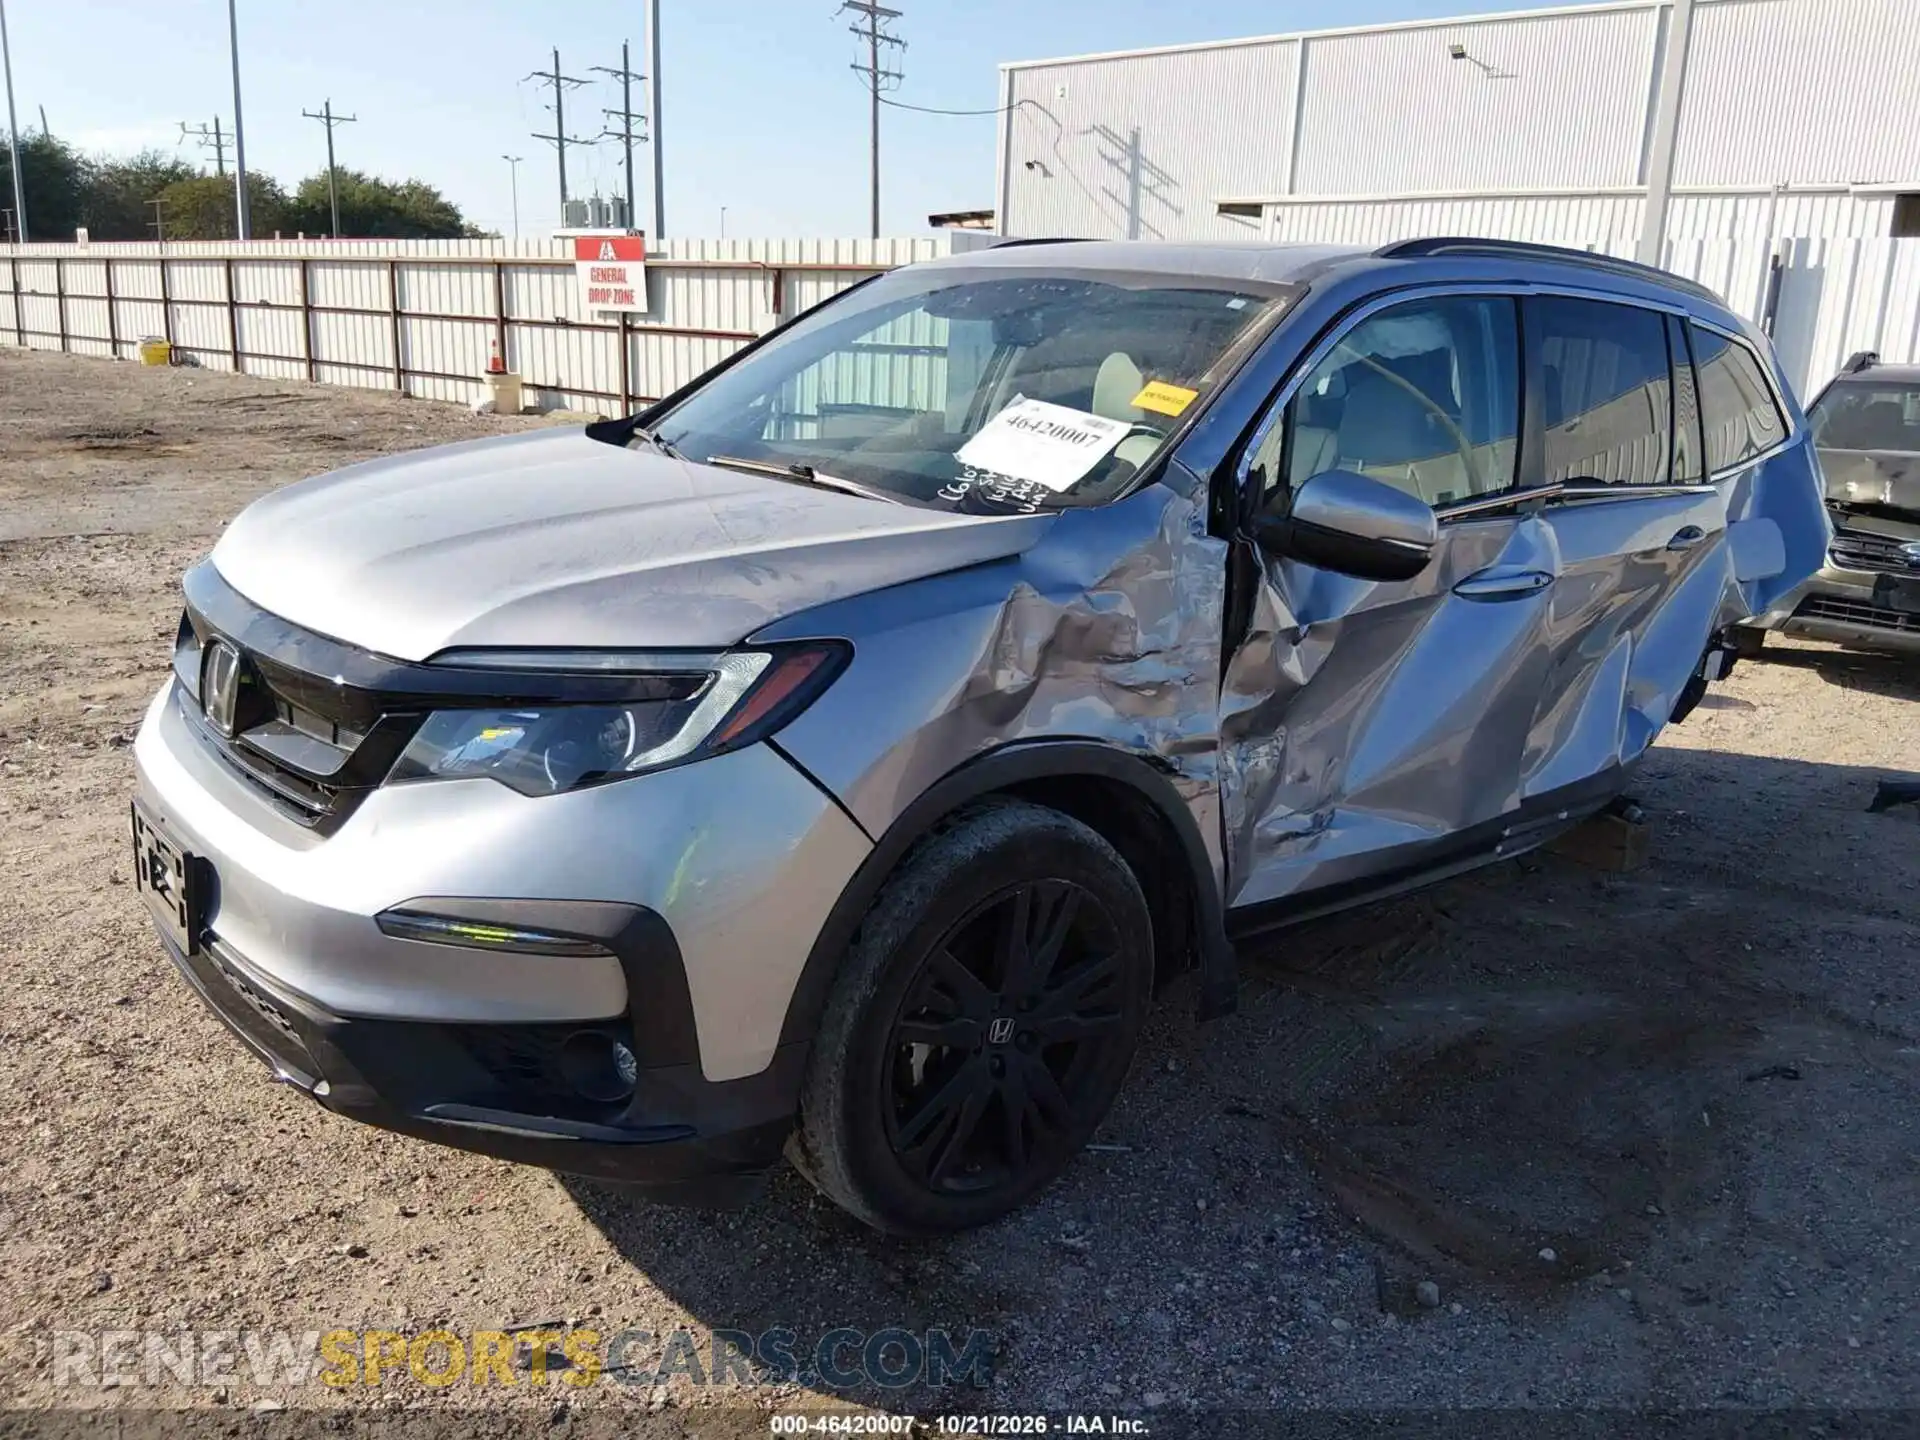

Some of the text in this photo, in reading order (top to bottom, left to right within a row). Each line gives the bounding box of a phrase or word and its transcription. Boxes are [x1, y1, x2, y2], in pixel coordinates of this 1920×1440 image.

[590, 267, 627, 283] GENERAL
[589, 287, 635, 305] DROP ZONE
[1007, 415, 1102, 449] 46420007
